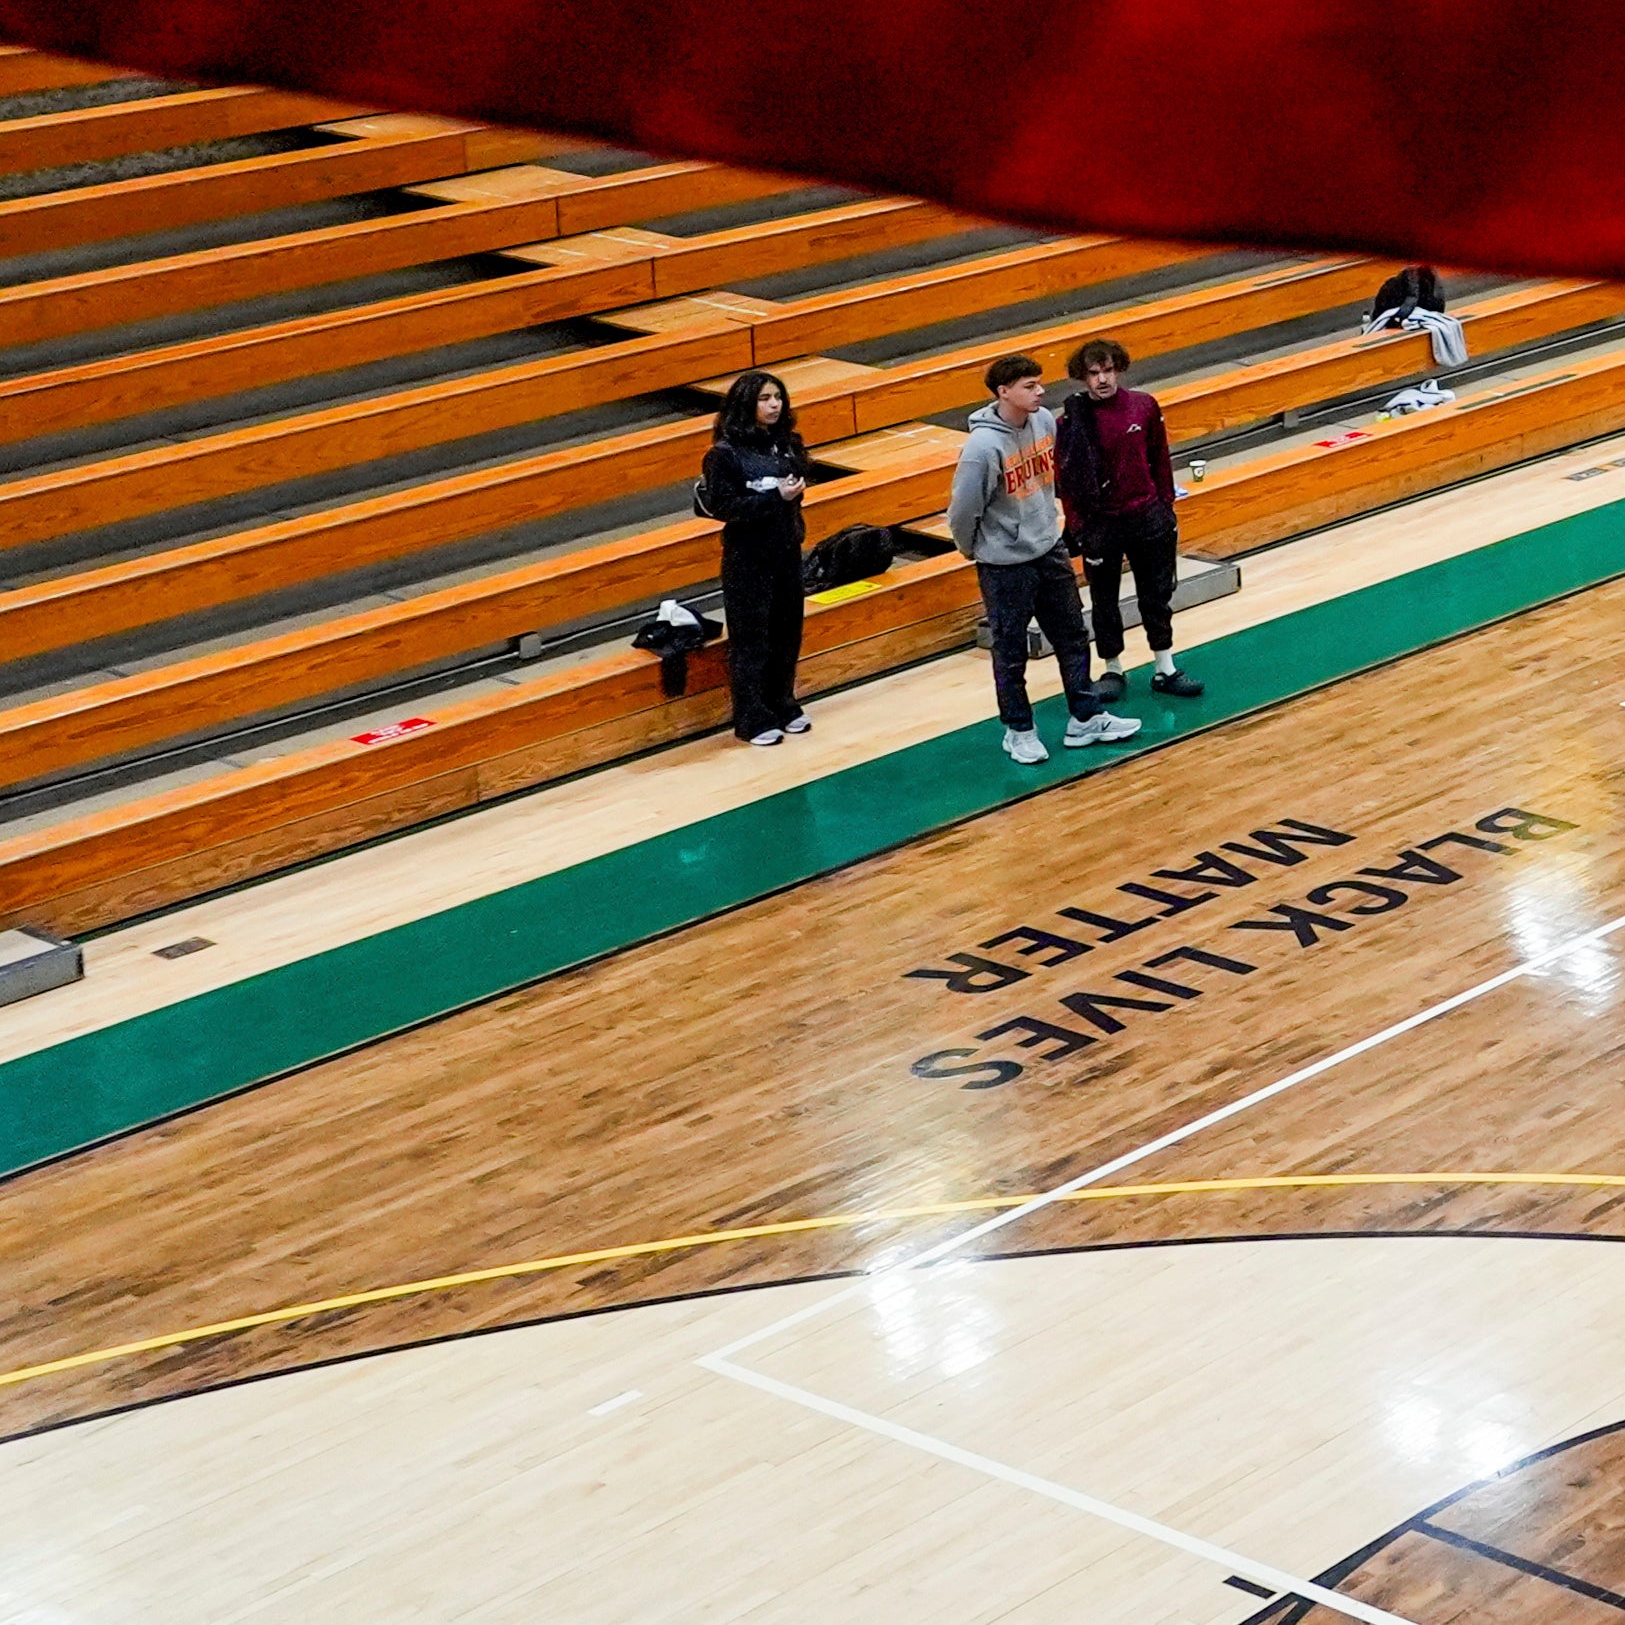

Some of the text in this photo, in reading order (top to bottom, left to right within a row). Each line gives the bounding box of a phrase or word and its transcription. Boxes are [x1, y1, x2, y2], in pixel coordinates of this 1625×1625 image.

[1005, 448, 1057, 494] BRUINS
[902, 818, 1356, 994] MATTER
[909, 807, 1580, 1090] BLACK LIVES
